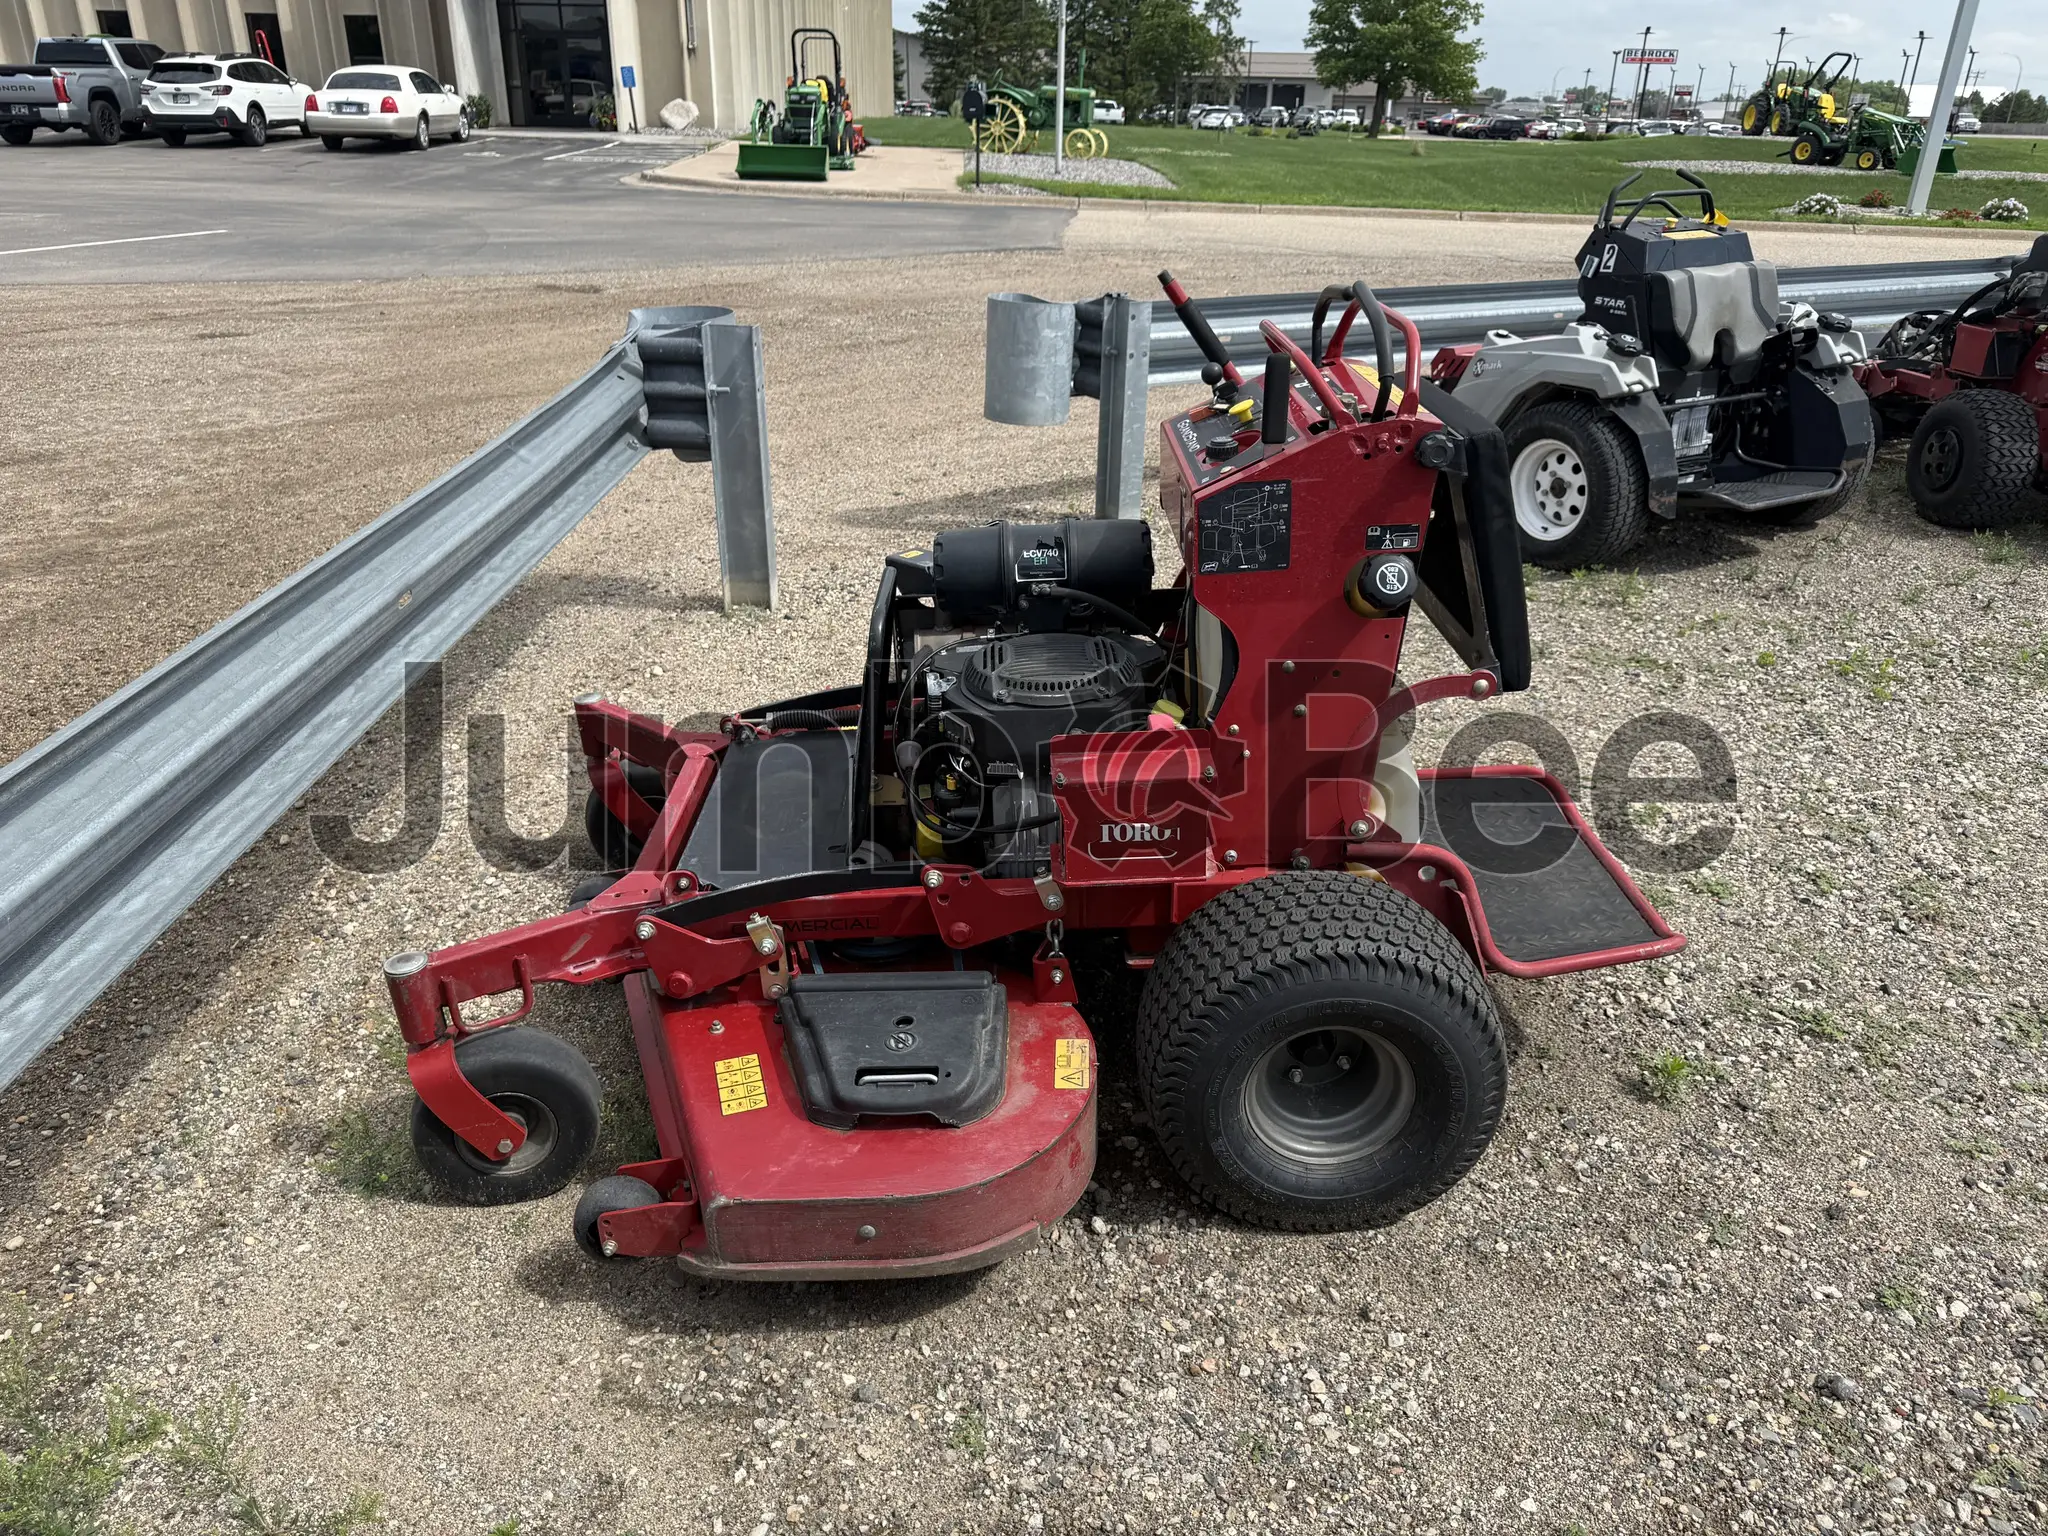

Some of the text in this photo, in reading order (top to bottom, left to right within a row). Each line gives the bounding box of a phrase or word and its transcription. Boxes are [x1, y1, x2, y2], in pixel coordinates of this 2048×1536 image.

[1602, 245, 1616, 270] 2
[1023, 549, 1059, 558] ECV740
[1034, 556, 1048, 566] EFI
[731, 916, 880, 936] CMERCIAL
